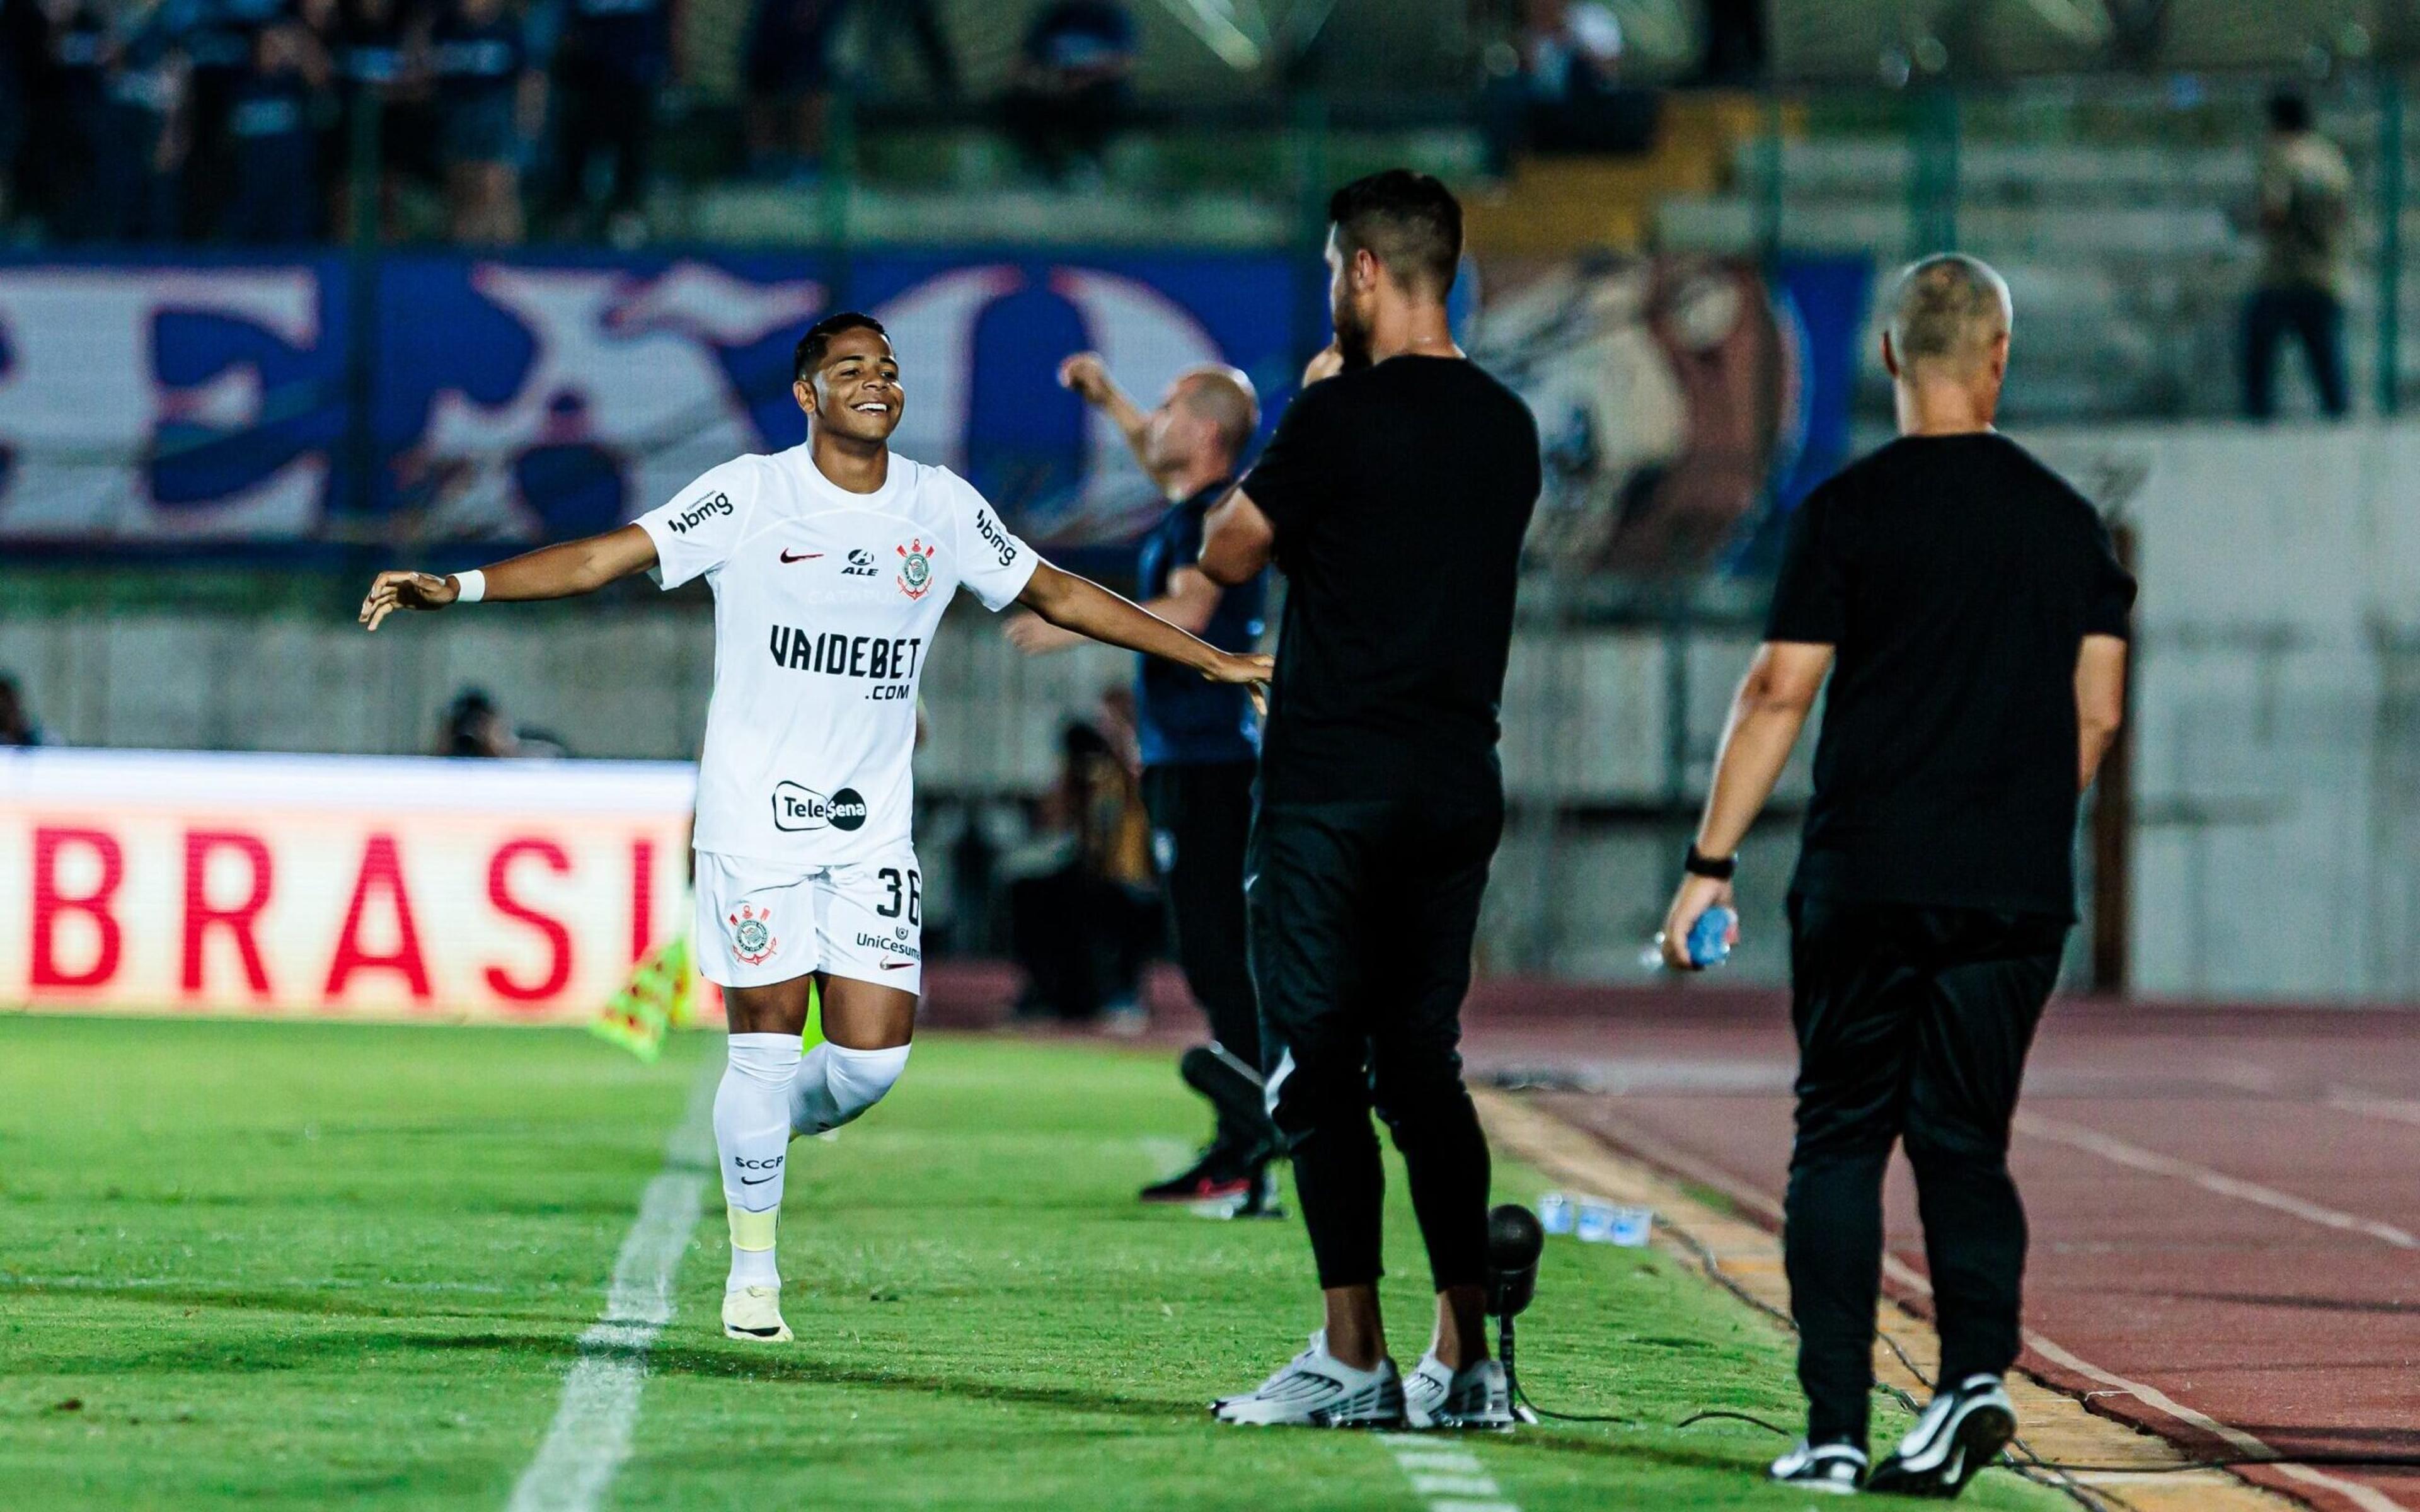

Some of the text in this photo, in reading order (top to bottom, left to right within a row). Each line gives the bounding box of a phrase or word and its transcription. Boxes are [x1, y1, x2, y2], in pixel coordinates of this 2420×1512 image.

[680, 492, 734, 529] bmg
[981, 518, 1017, 567] bmg
[841, 566, 879, 576] ALE
[770, 624, 921, 679] VAIDEBET
[865, 684, 910, 701] .COM
[877, 867, 921, 927] 36
[29, 827, 726, 1014] BRASI
[735, 1155, 784, 1170] SCCP
